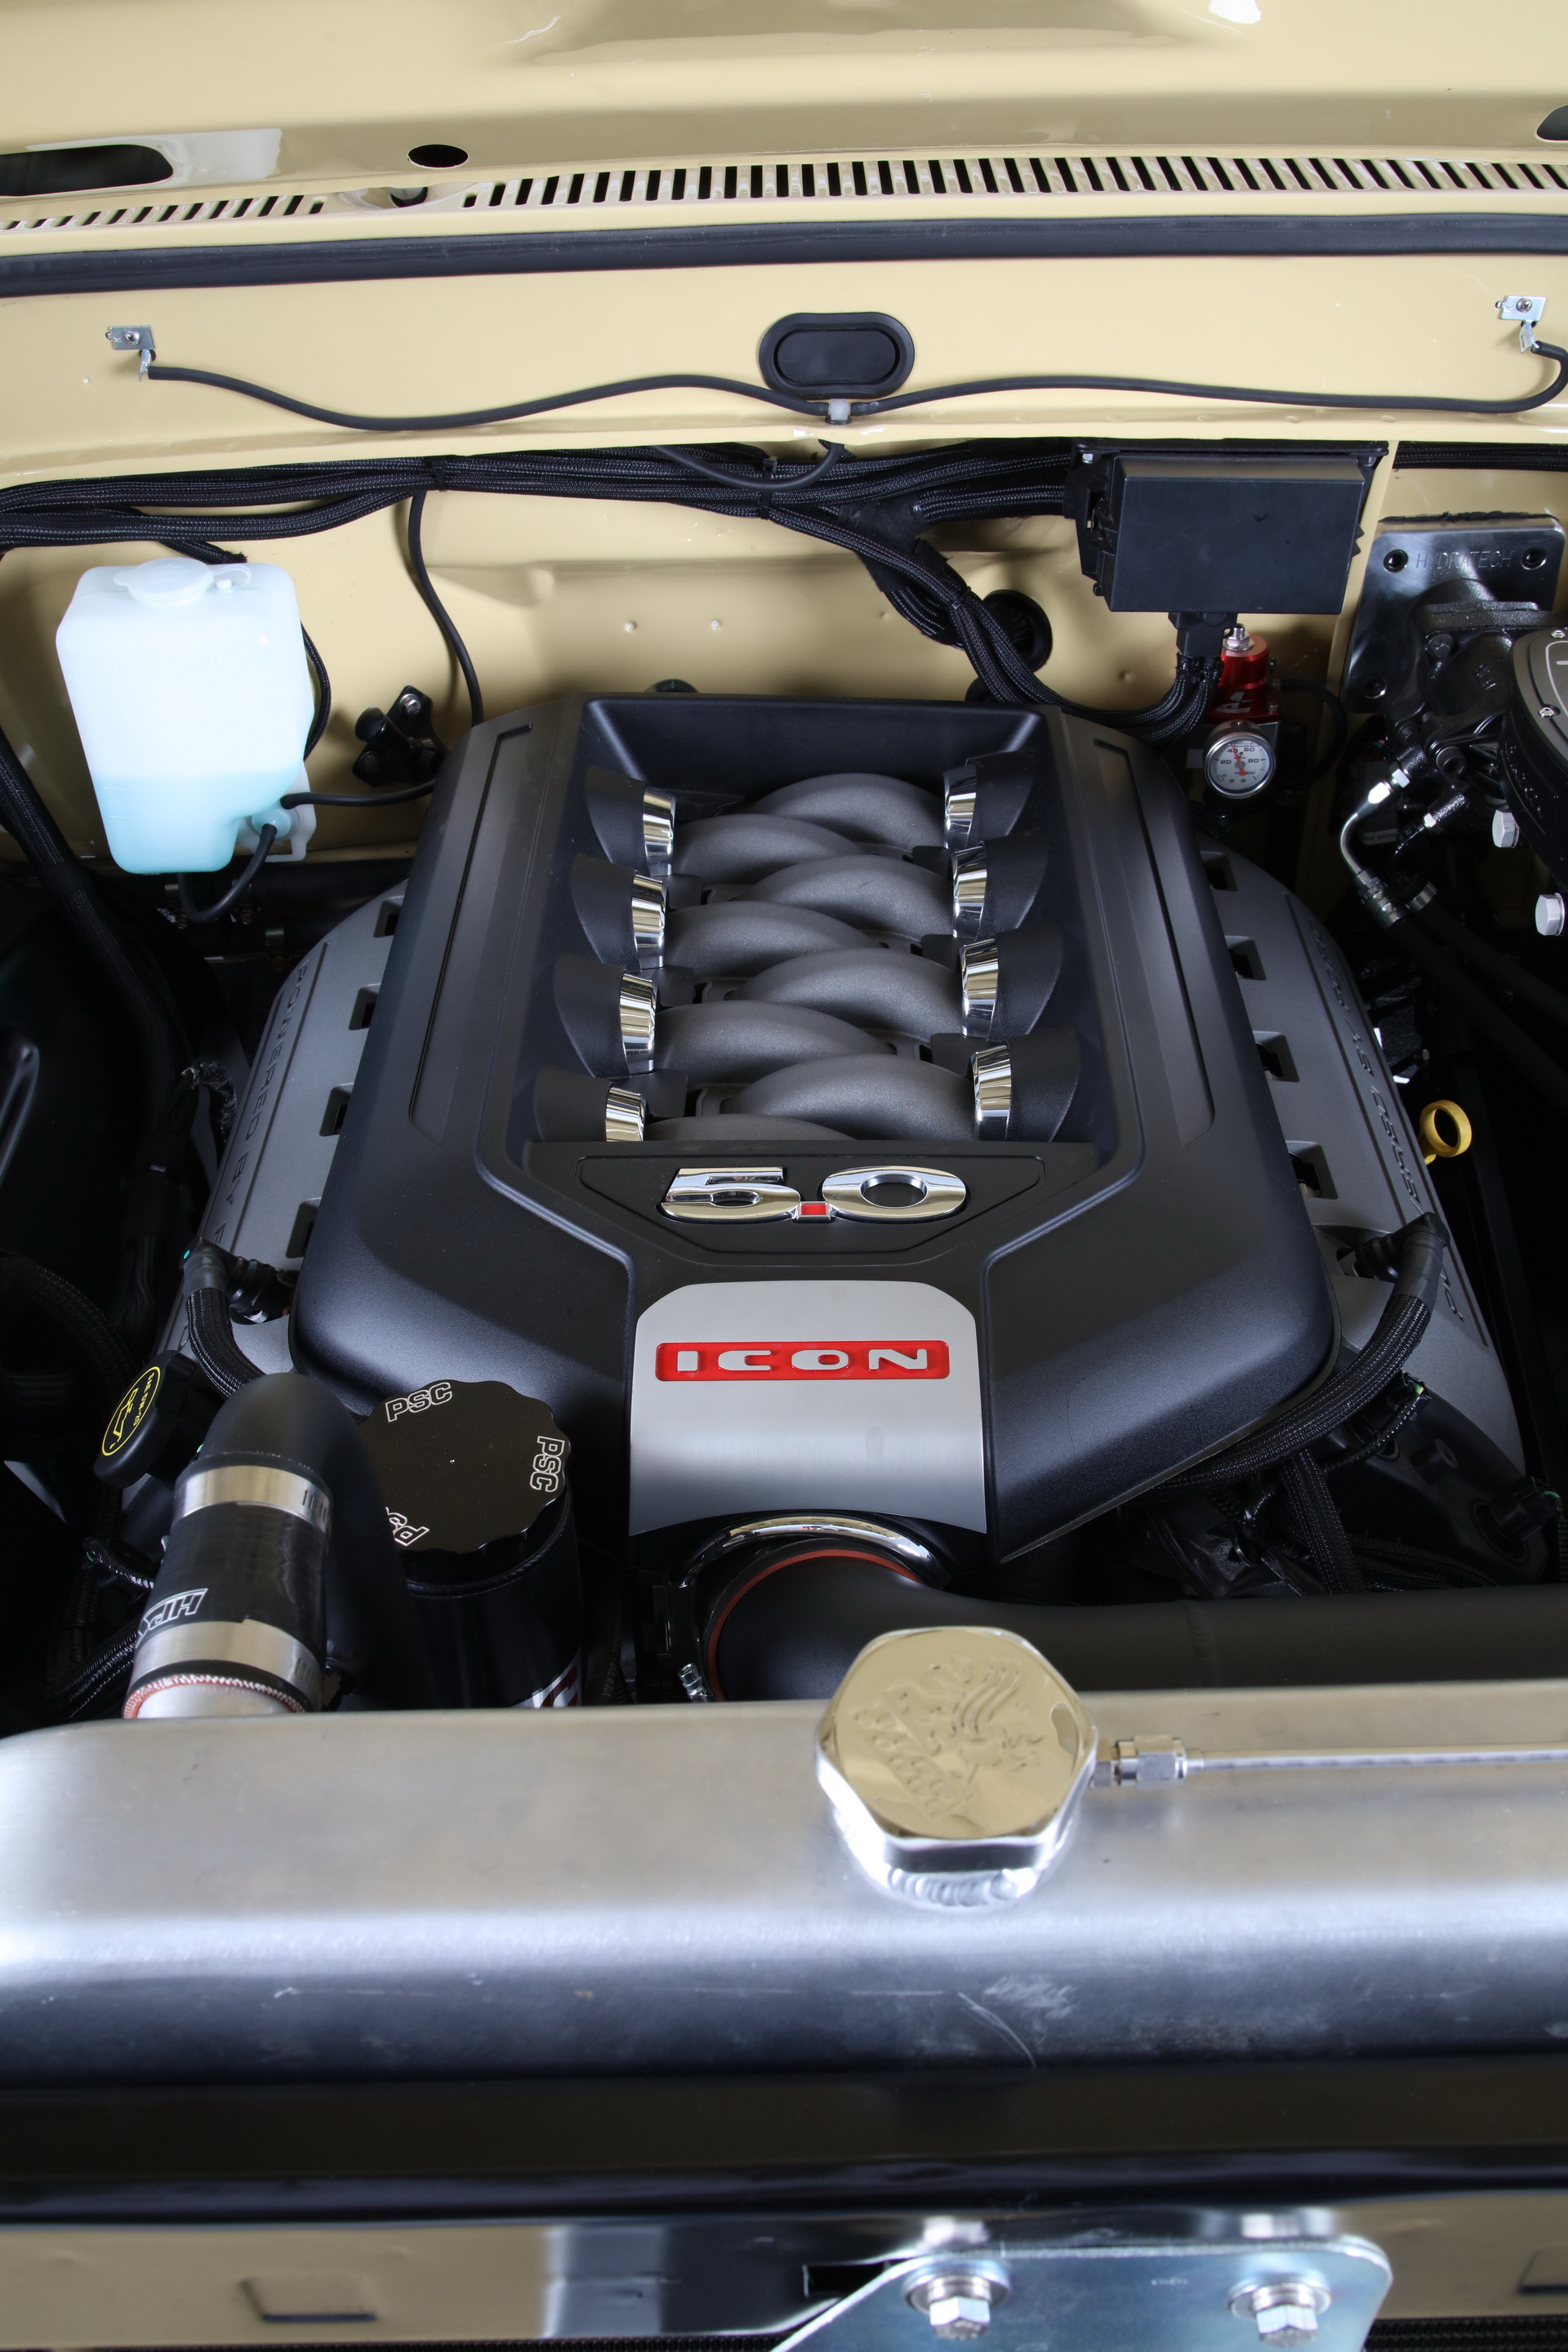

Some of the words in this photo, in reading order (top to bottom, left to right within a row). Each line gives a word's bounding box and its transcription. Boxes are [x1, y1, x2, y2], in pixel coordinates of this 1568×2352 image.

[1416, 550, 1511, 569] HYDRATECH
[246, 959, 310, 1141] POWERED
[225, 1148, 250, 1205] BY
[661, 1165, 968, 1224] 5.0
[676, 1348, 930, 1374] ICON
[385, 1381, 453, 1423] PSC
[528, 1435, 566, 1494] PSC
[385, 1506, 430, 1548] PS
